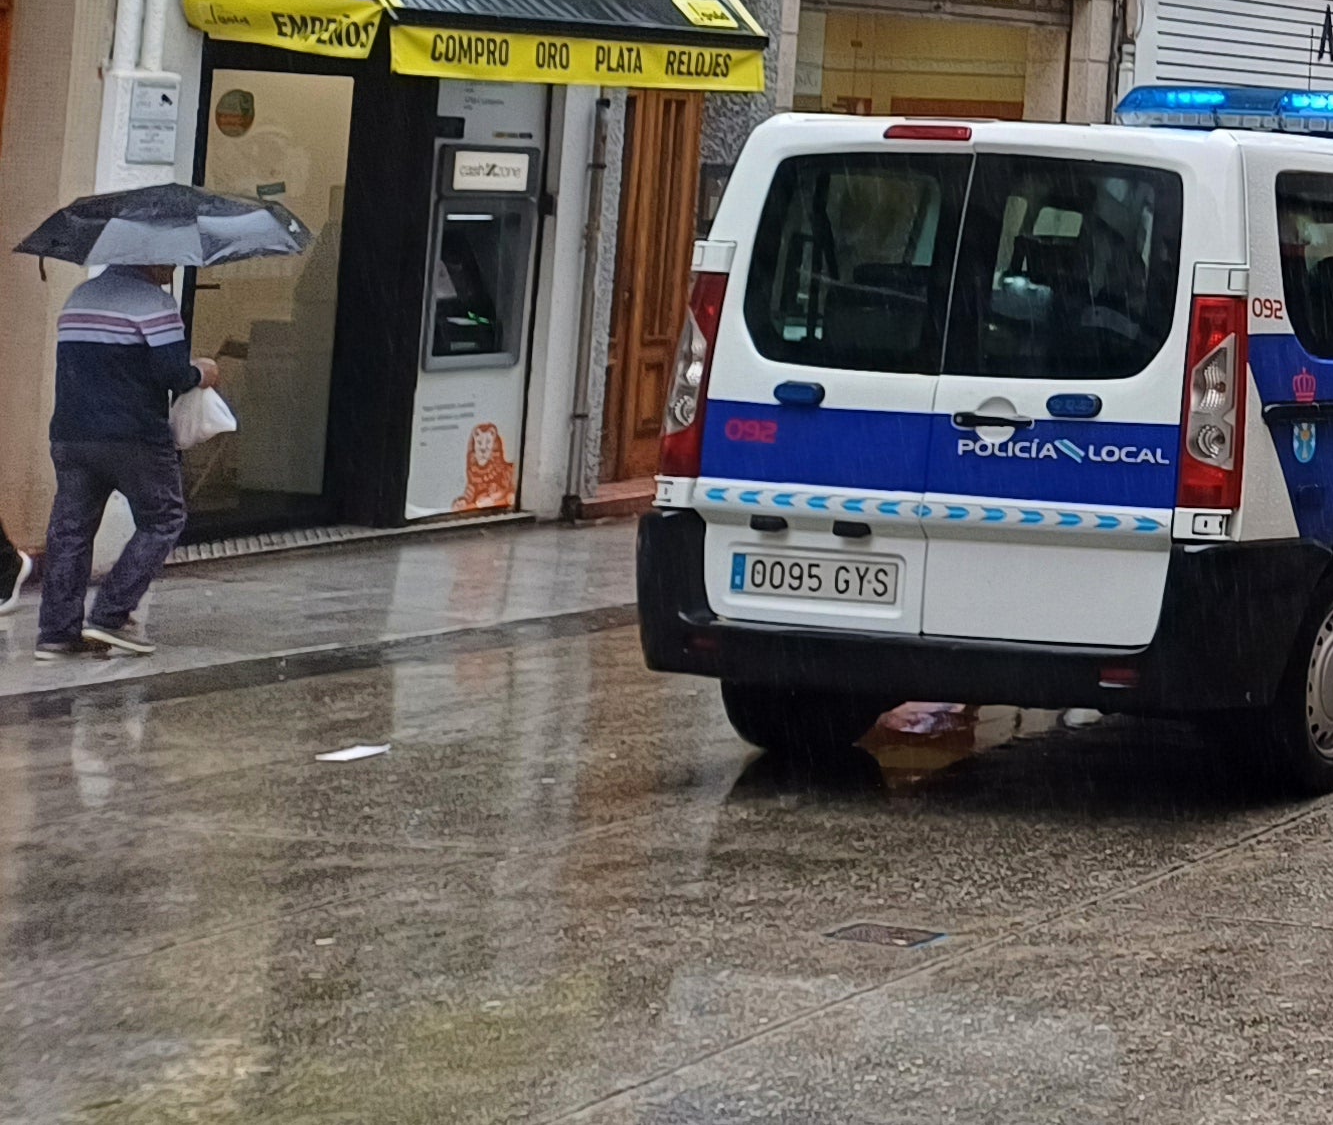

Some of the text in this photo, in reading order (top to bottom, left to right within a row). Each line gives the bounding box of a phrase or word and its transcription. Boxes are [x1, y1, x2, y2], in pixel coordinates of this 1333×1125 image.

[273, 11, 375, 49] EMPEÑOS
[430, 33, 733, 79] COMPRO ORO PLATA RELOJES
[1252, 297, 1283, 320] 092
[725, 418, 778, 444] 092
[957, 438, 1170, 465] POLICÍA LOCAL
[751, 559, 889, 597] 0095 GYS
